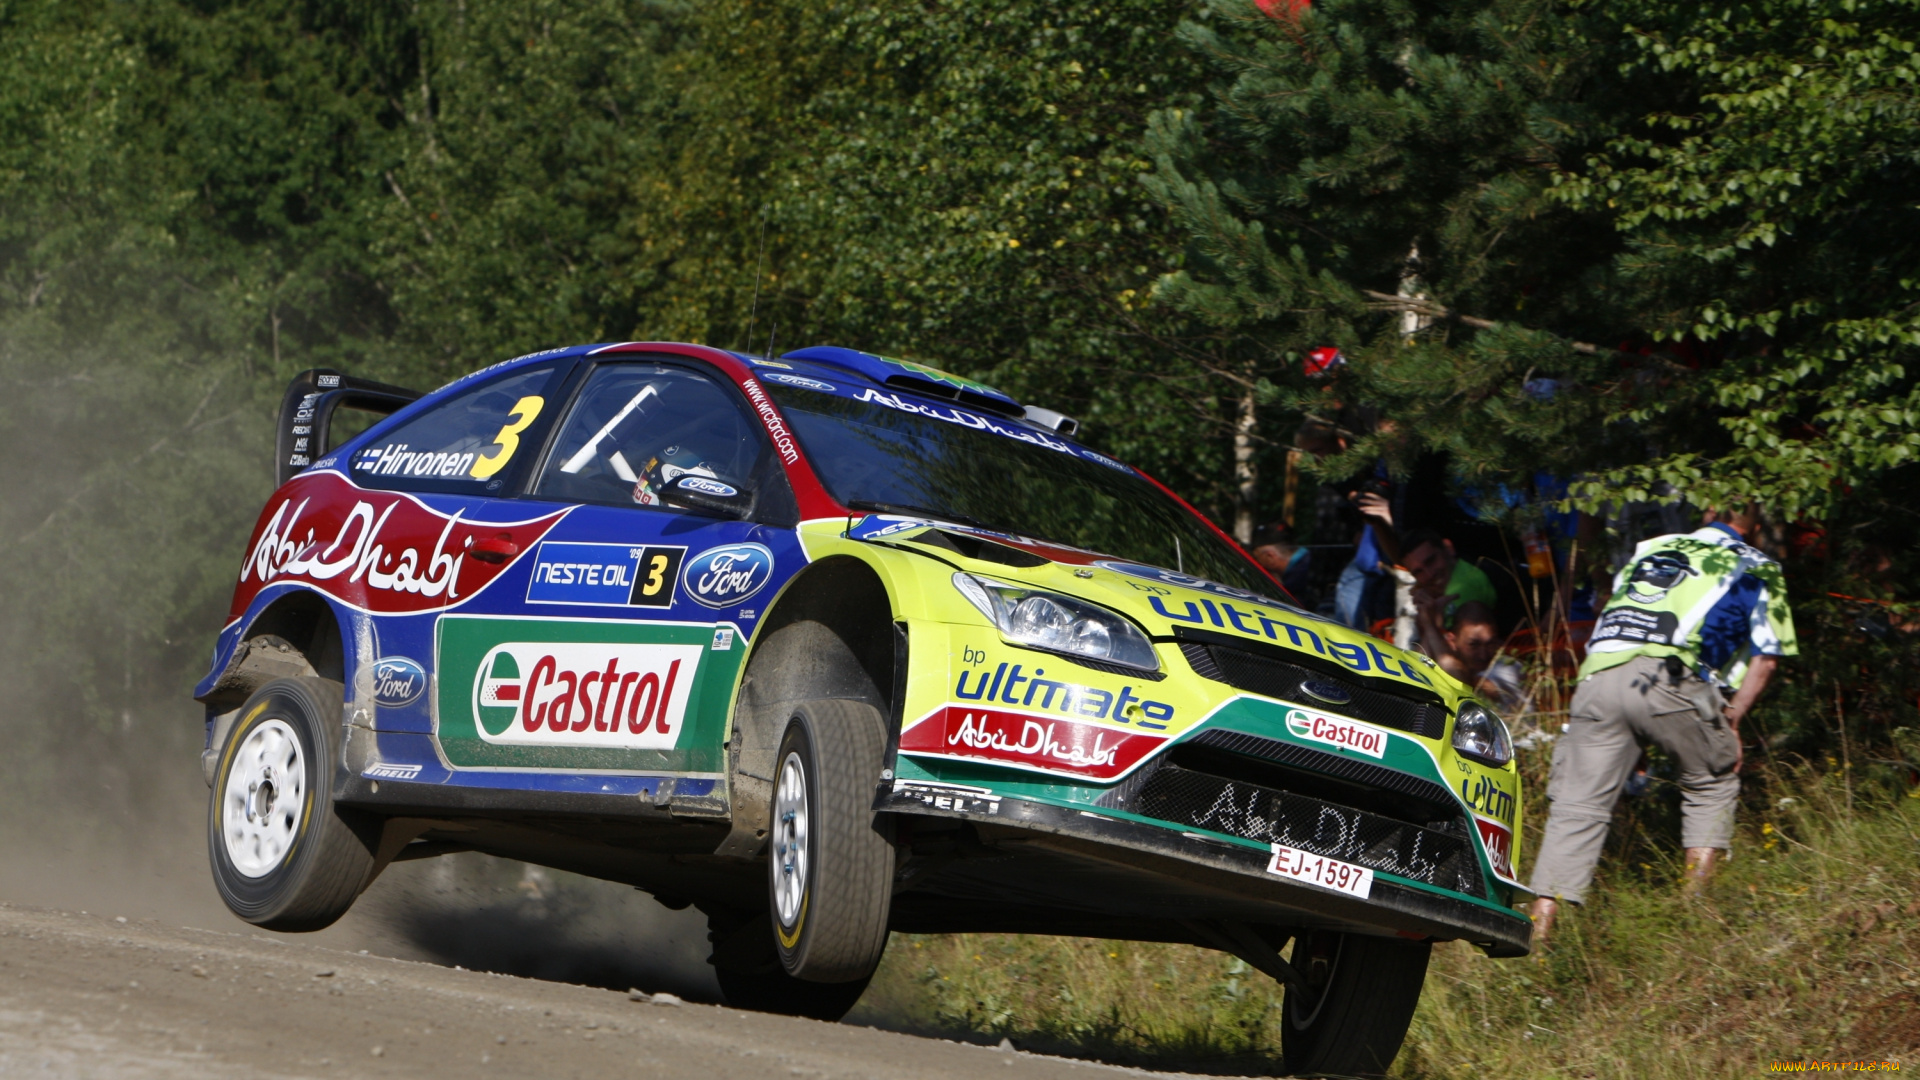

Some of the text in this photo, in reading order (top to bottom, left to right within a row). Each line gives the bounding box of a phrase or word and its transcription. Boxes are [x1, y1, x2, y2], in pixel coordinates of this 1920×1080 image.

[778, 375, 823, 389] Ford
[297, 408, 315, 418] OZ
[743, 378, 799, 466] www.wrcford.com
[469, 395, 545, 479] 3
[372, 443, 474, 477] Hirvonen
[688, 478, 726, 494] Ford
[535, 562, 630, 587] NESTE OIL
[642, 554, 668, 596] 3
[698, 552, 752, 598] Ford
[1125, 580, 1172, 597] bp
[963, 644, 986, 668] bp
[1147, 595, 1433, 687] ultimate
[373, 660, 413, 698] Ford
[521, 654, 682, 735] Castrol
[955, 662, 1175, 730] ultimate
[1311, 716, 1381, 754] Castrol
[364, 761, 423, 780] PIRELLI
[1454, 755, 1472, 777] bp
[1275, 847, 1363, 891] EJ-1597
